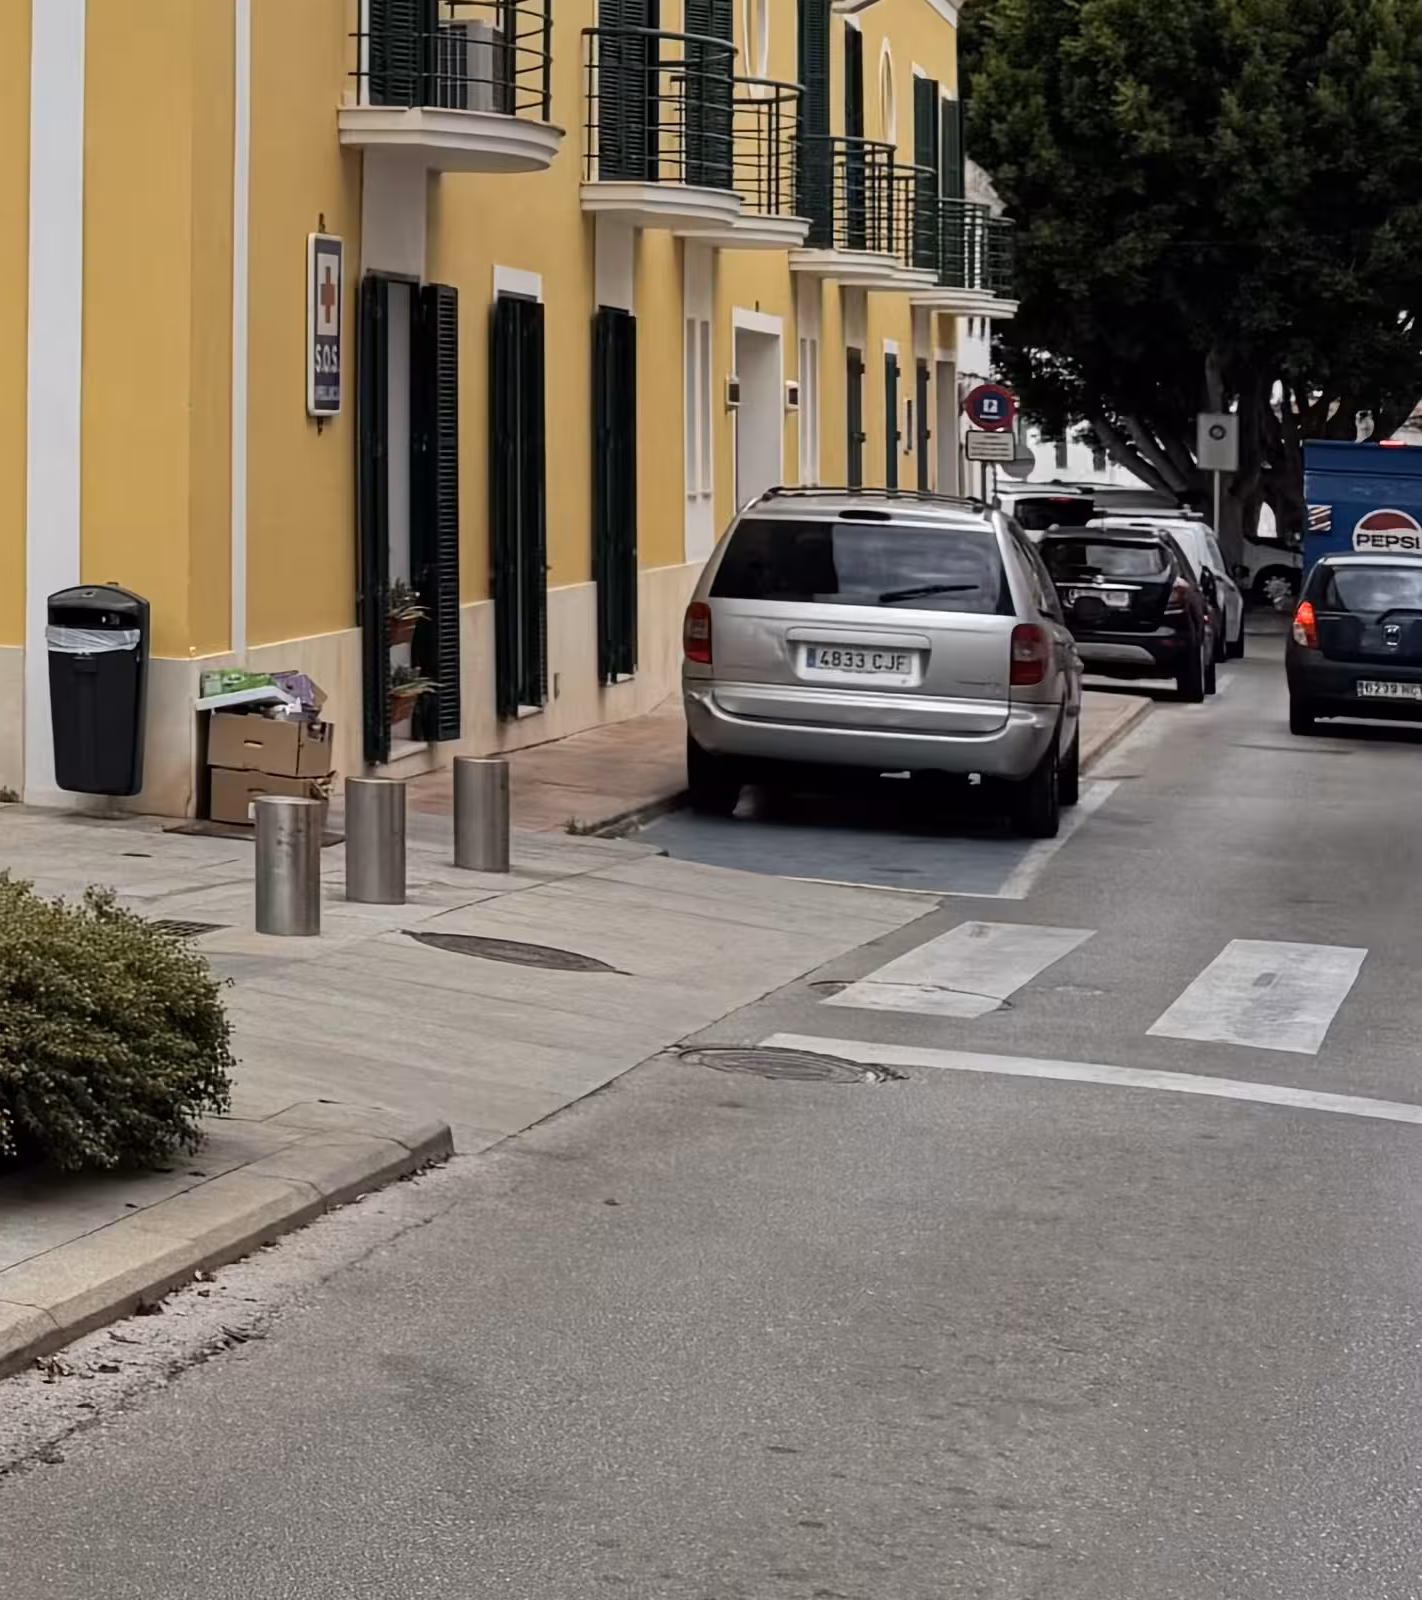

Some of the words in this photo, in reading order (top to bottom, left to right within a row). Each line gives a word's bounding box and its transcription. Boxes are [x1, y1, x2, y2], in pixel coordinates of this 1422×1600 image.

[1356, 533, 1421, 549] PEPSI
[819, 650, 865, 669] 4833
[872, 653, 906, 671] CJF
